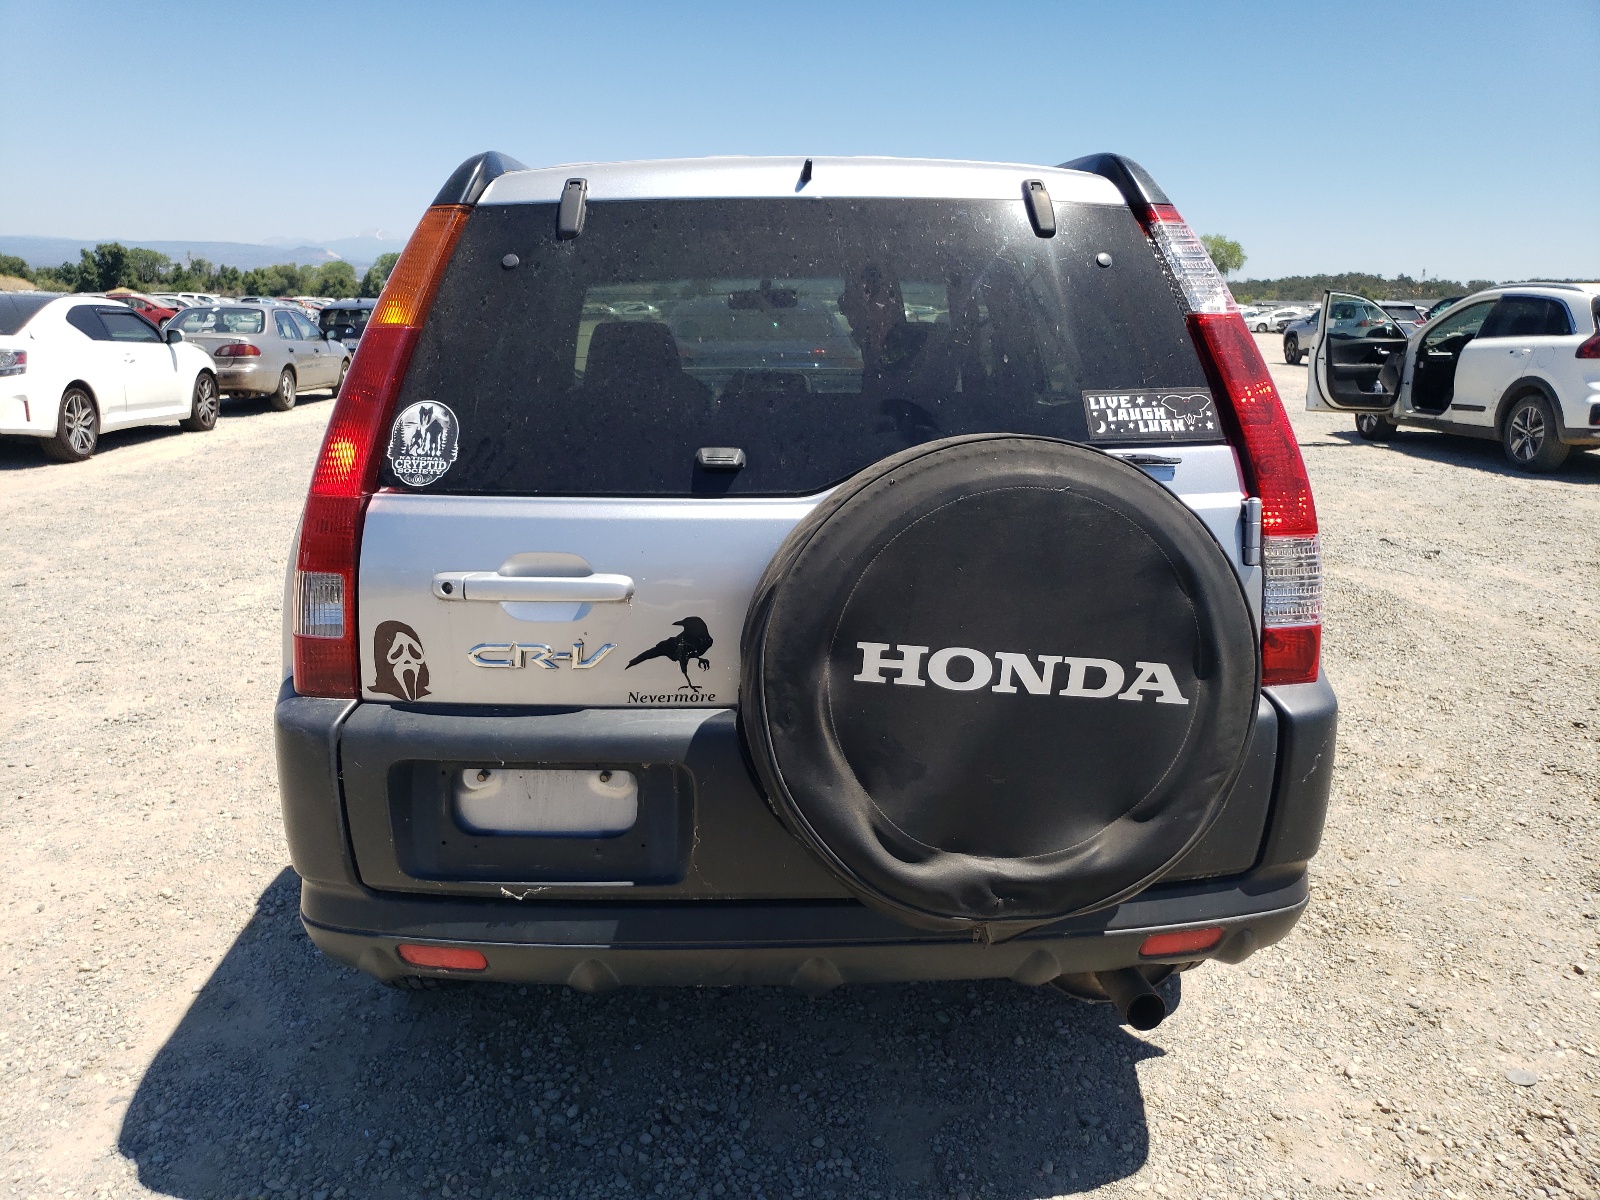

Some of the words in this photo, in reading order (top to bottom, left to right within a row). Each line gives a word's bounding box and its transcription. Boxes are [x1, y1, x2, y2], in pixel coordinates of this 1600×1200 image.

[1089, 396, 1131, 409] LIVE
[1106, 407, 1166, 421] LAUGH
[1138, 419, 1186, 432] LURK
[394, 459, 447, 470] CRYPTID
[467, 641, 618, 670] CR-V
[853, 641, 1190, 705] HONDA
[626, 691, 716, 704] Nevermore
